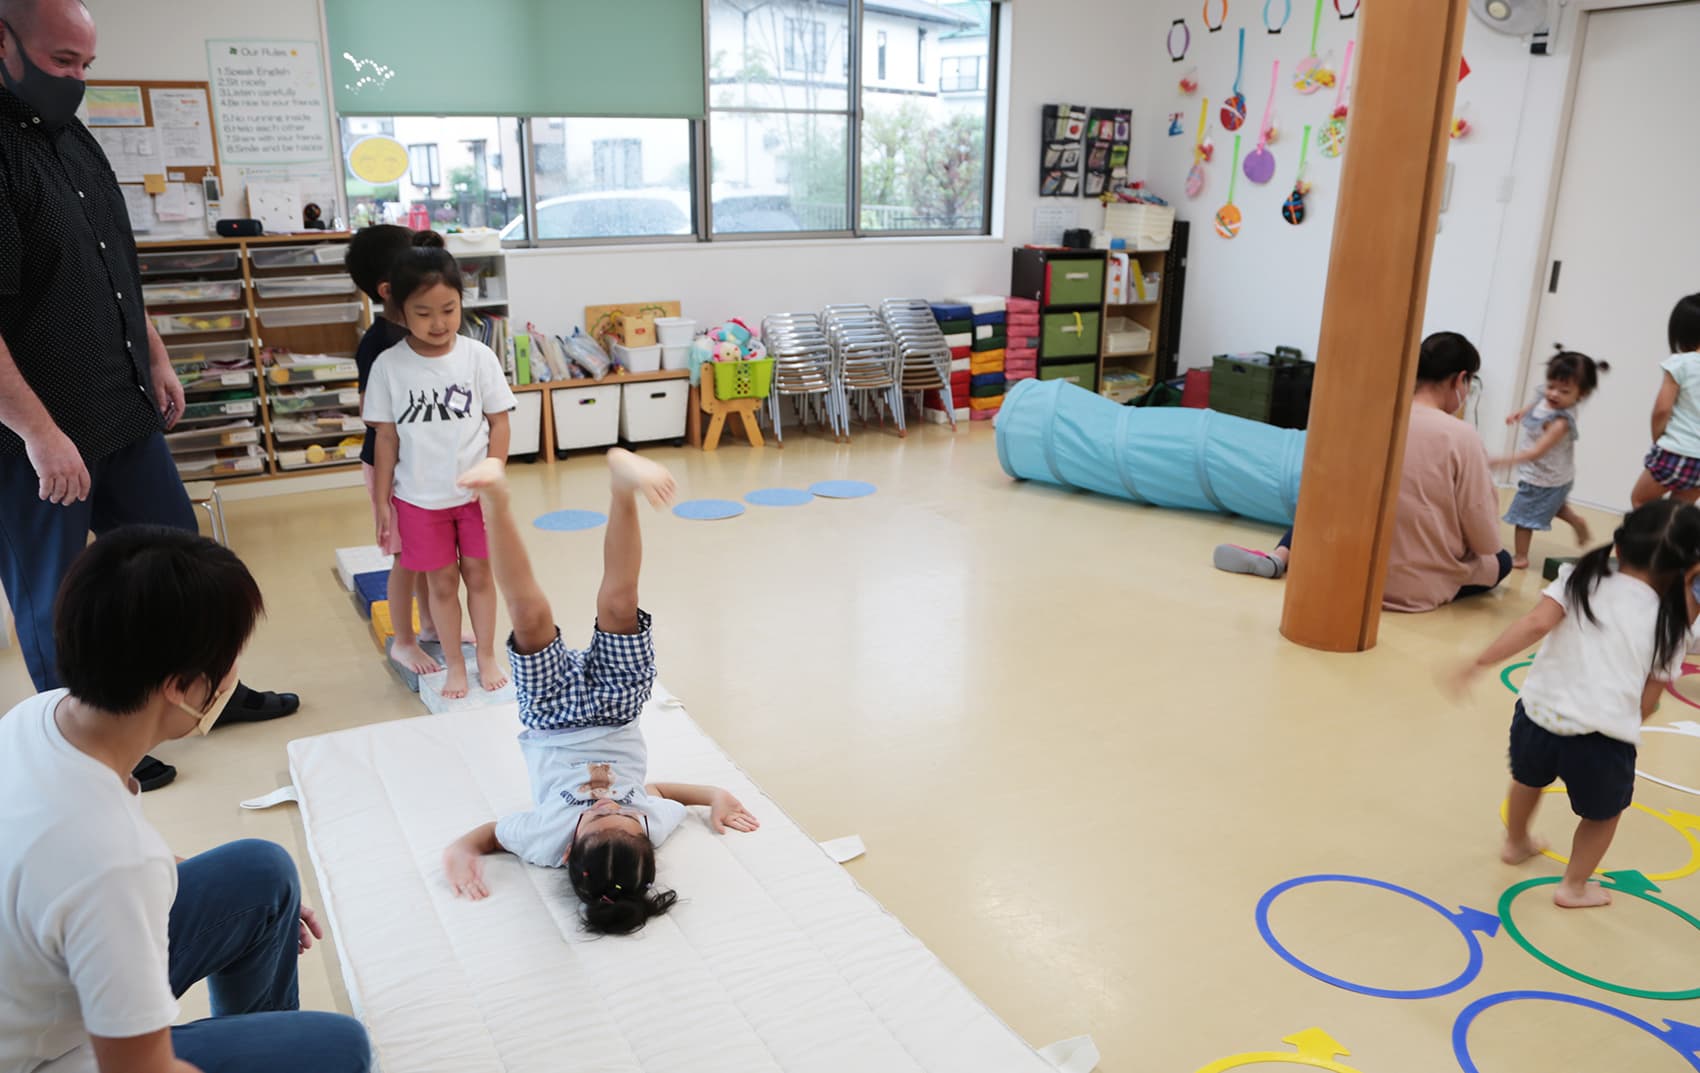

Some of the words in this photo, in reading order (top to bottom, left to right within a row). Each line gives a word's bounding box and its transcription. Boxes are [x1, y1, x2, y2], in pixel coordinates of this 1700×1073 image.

[241, 48, 258, 57] Our
[262, 48, 288, 57] Rules
[257, 67, 291, 76] English
[241, 77, 266, 87] nicely
[258, 87, 297, 97] carefully
[292, 98, 321, 106] friends
[246, 114, 284, 123] running
[286, 113, 312, 121] inside
[256, 124, 278, 132] each
[281, 123, 305, 132] other
[257, 134, 275, 142] with
[277, 135, 294, 143] your
[296, 133, 323, 142] friends
[261, 144, 280, 152] and
[282, 143, 294, 152] be
